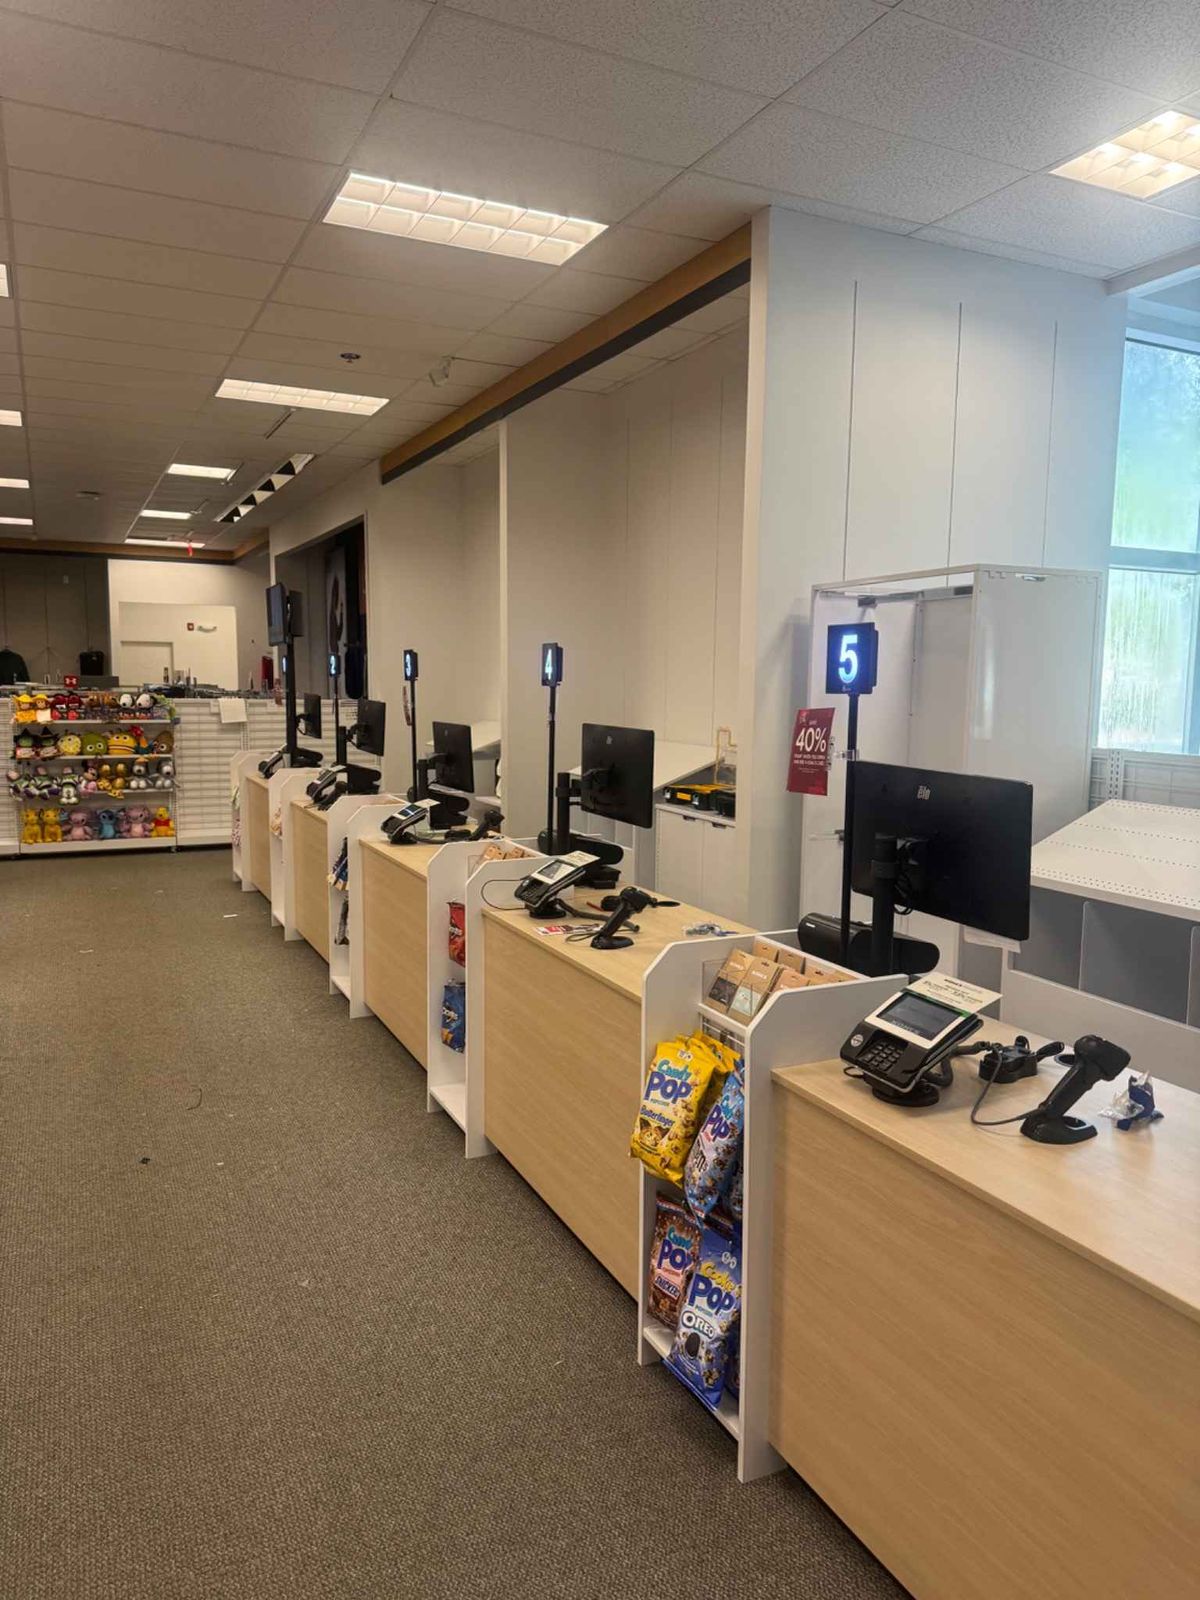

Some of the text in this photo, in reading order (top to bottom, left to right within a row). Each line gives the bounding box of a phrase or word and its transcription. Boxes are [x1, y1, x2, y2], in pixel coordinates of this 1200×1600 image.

[545, 649, 553, 680] 4
[838, 634, 858, 684] 5
[795, 727, 827, 753] 40%
[681, 1310, 715, 1339] OREO
